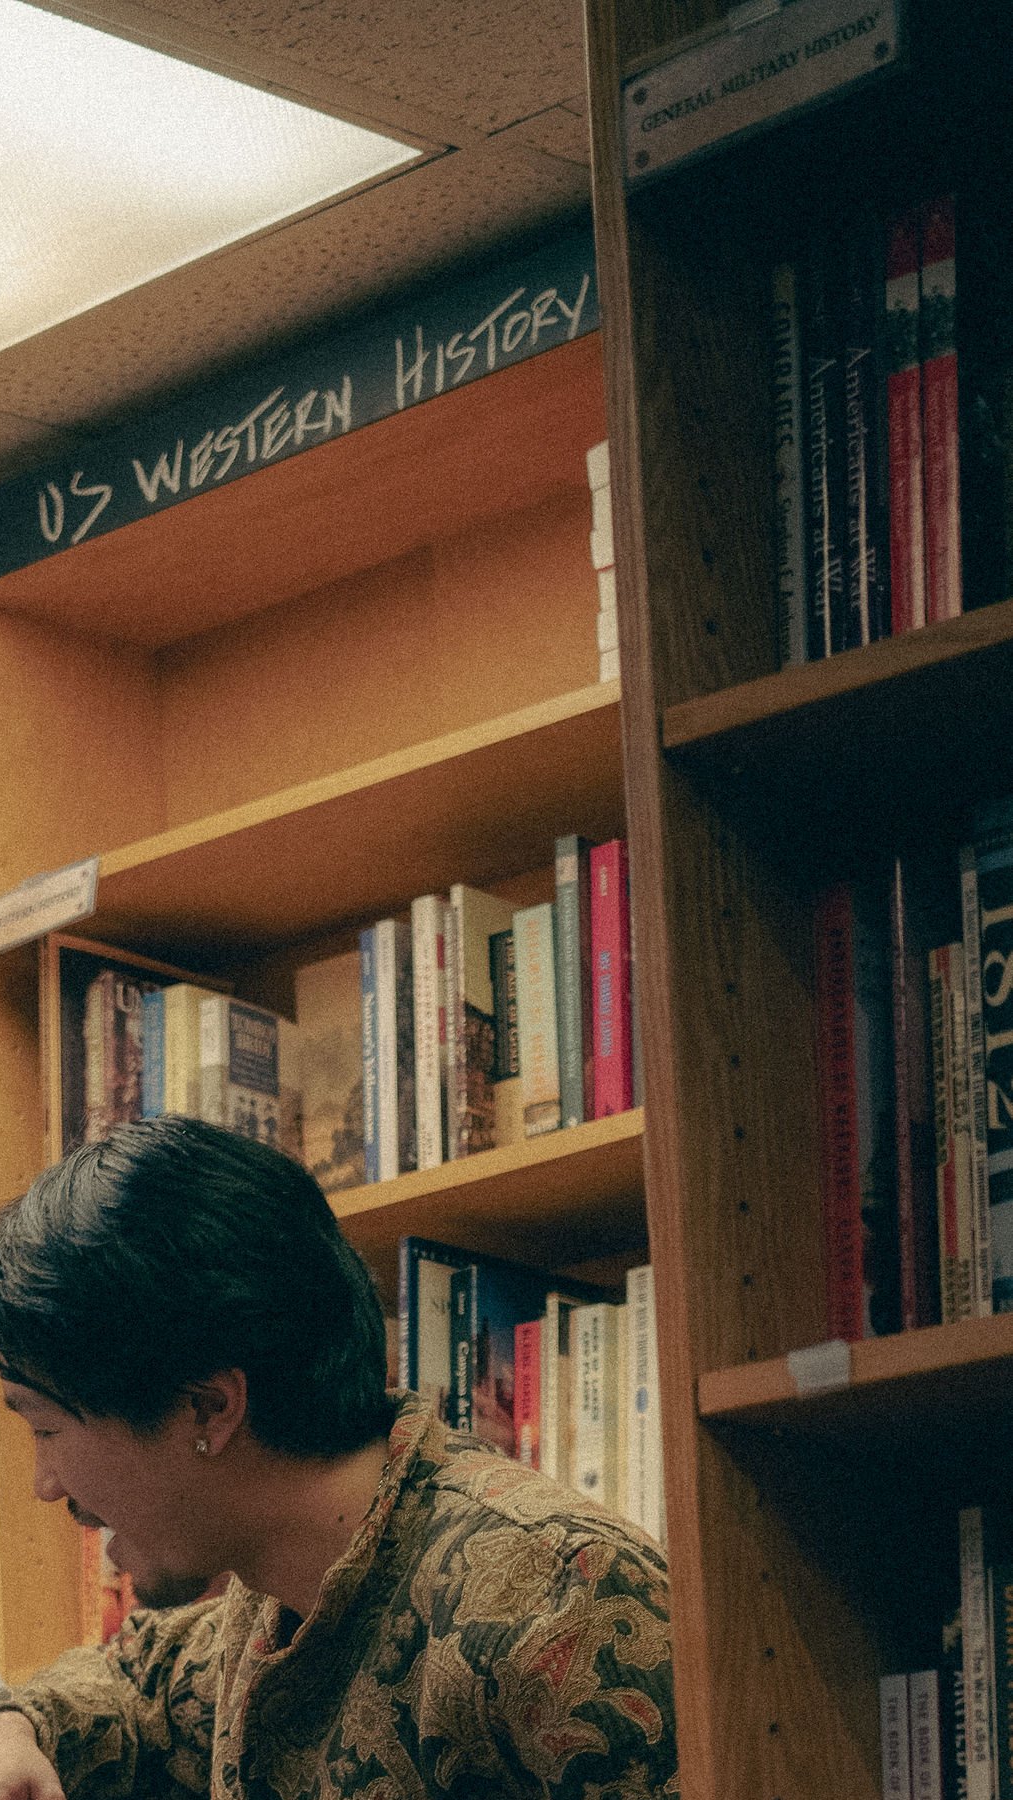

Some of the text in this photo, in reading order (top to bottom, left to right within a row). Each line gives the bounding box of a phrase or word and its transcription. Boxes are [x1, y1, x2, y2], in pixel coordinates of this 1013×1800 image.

[640, 10, 882, 133] GENERAL MILITARY HISTORY
[38, 275, 589, 545] US WESTERN HISTORY
[808, 357, 836, 516] Americans
[845, 348, 870, 504] Americans
[812, 528, 834, 556] at
[848, 517, 864, 544] at
[508, 1028, 519, 1072] GOLD
[454, 1341, 469, 1395] Canyon
[457, 1399, 469, 1415] de
[971, 1649, 986, 1674] The
[915, 1692, 929, 1721] THE
[972, 1679, 986, 1706] War
[885, 1697, 899, 1726] THE
[973, 1708, 988, 1723] of
[887, 1730, 901, 1770] BOOK
[917, 1726, 930, 1767] BOOK
[888, 1774, 902, 1794] OF
[919, 1771, 932, 1791] OF
